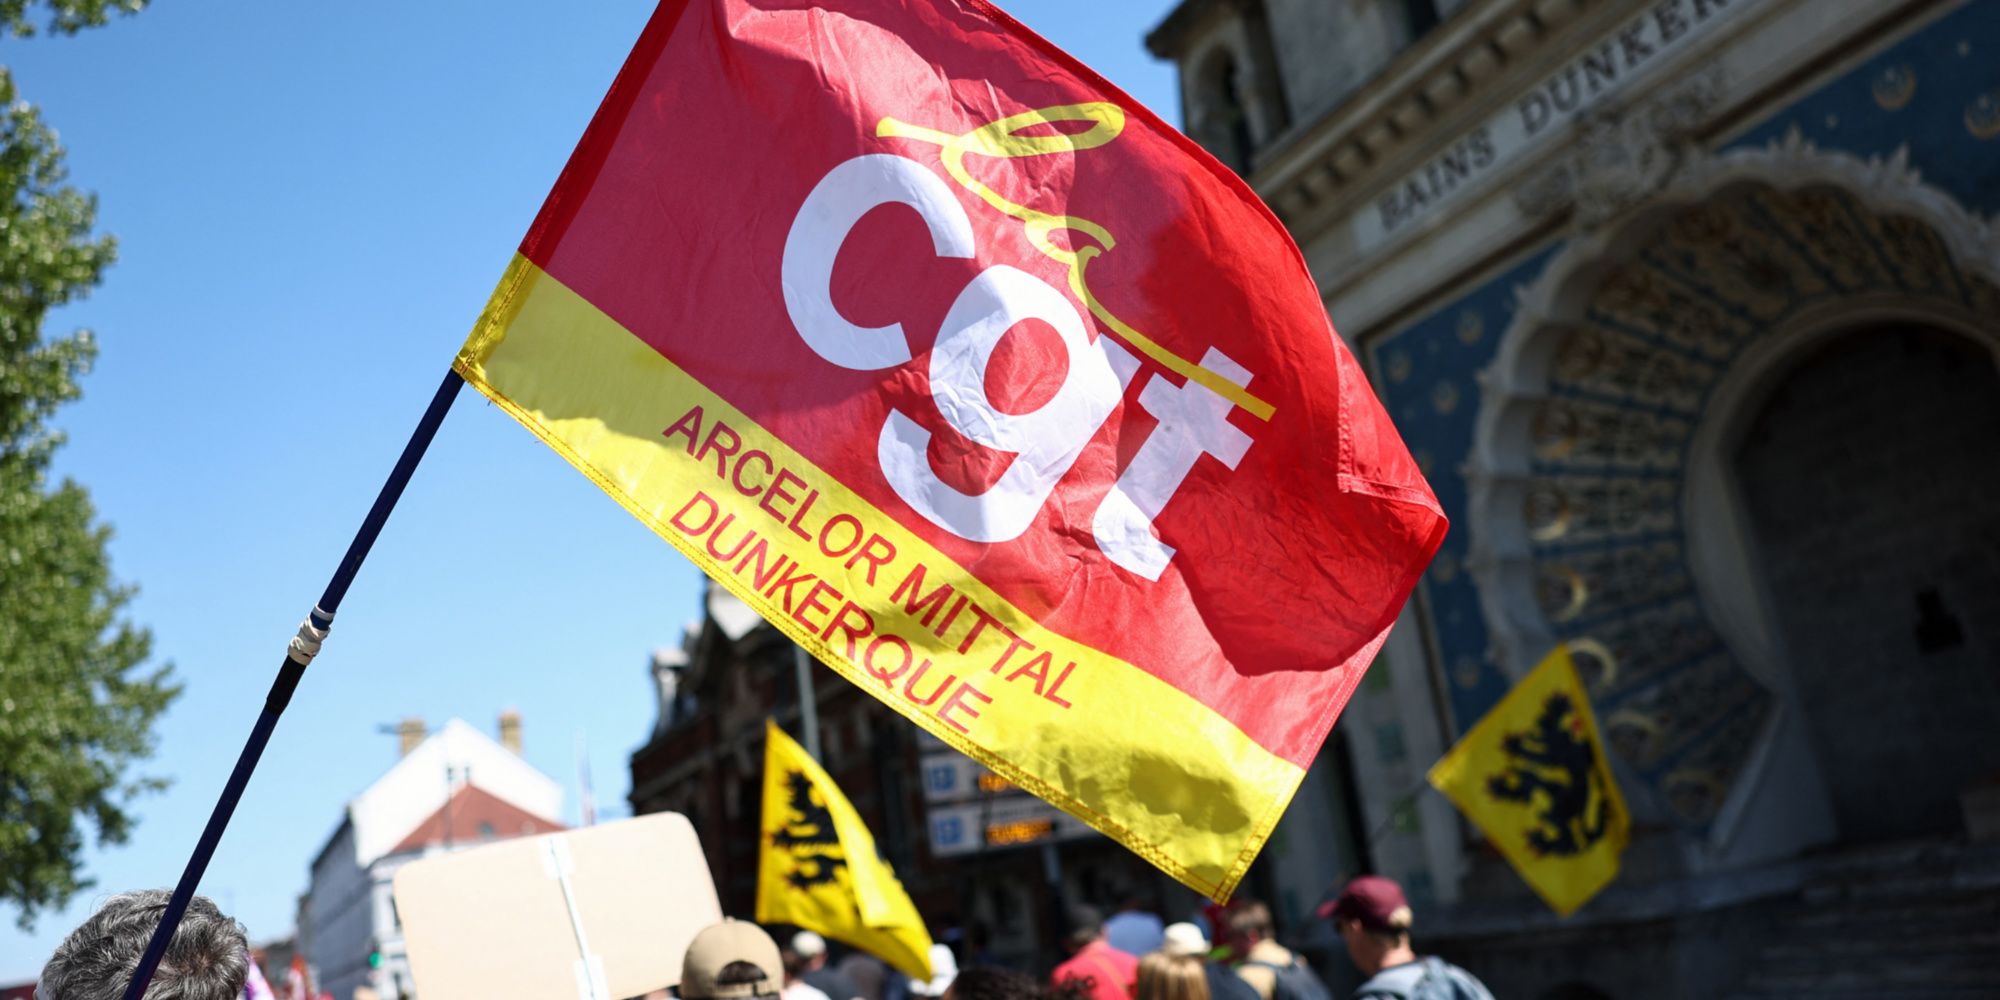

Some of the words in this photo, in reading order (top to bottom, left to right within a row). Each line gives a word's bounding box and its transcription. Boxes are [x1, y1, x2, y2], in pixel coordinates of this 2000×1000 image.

[1378, 126, 1497, 232] BAINS
[781, 152, 1255, 583] cgt
[662, 404, 897, 587] ARCELOR
[889, 562, 1078, 710] MITTAL
[669, 490, 994, 735] DUNKERQUE
